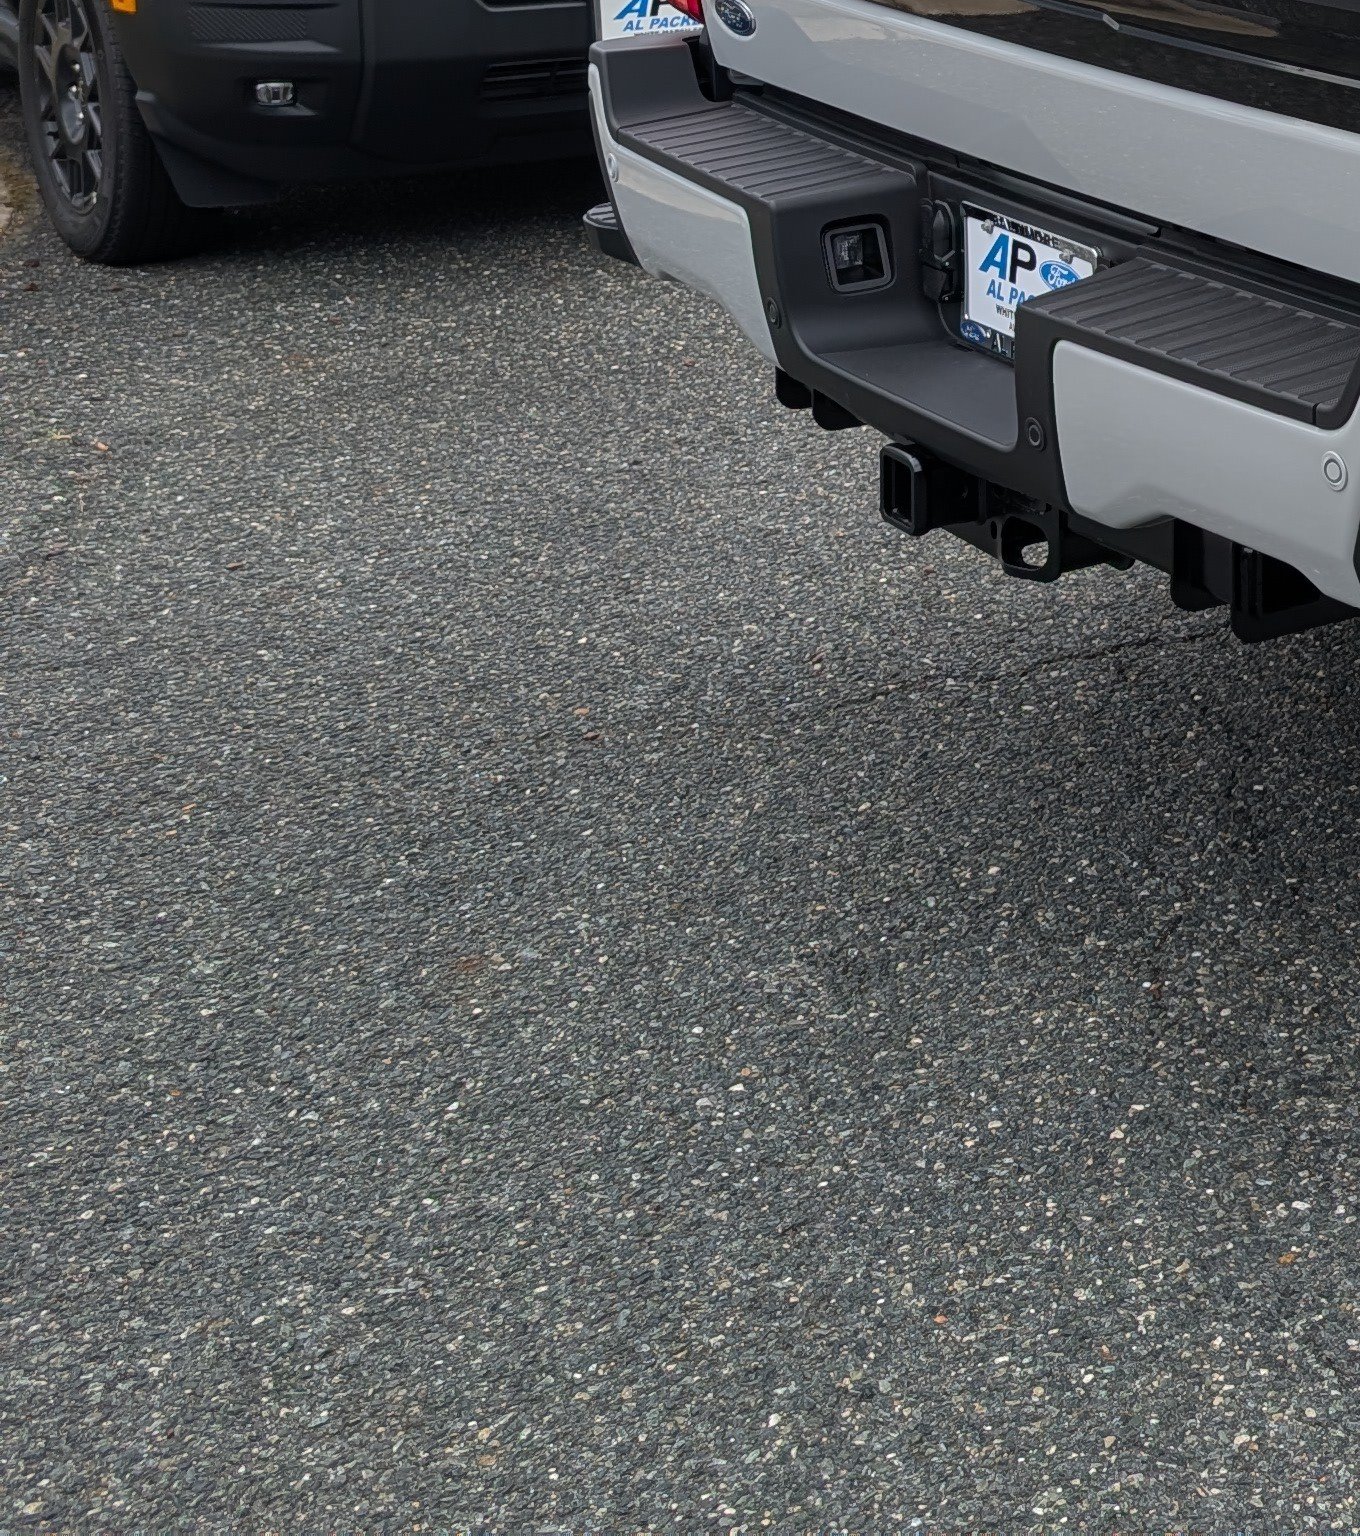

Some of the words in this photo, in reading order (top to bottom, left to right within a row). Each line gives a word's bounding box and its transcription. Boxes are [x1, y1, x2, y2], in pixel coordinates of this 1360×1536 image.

[622, 19, 644, 32] AL
[978, 232, 1037, 285] AP
[986, 278, 1005, 302] AL
